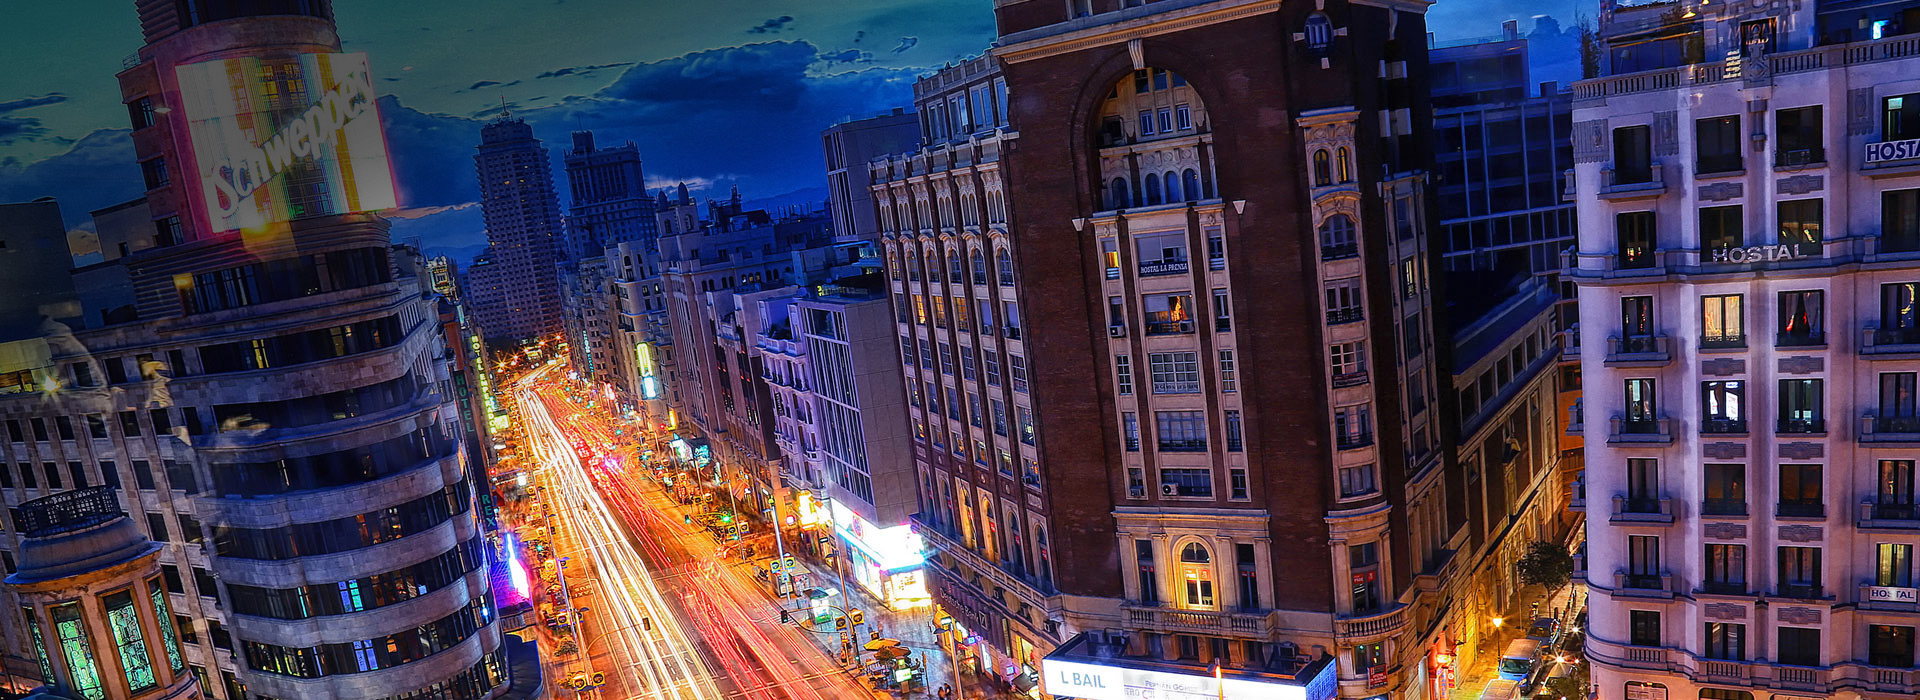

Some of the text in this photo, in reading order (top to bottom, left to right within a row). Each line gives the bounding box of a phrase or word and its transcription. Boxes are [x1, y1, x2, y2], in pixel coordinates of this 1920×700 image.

[209, 66, 374, 219] Schweppes
[1712, 244, 1808, 263] HOSTAL
[472, 335, 484, 371] HOTEL
[456, 374, 496, 527] HOTEL REX
